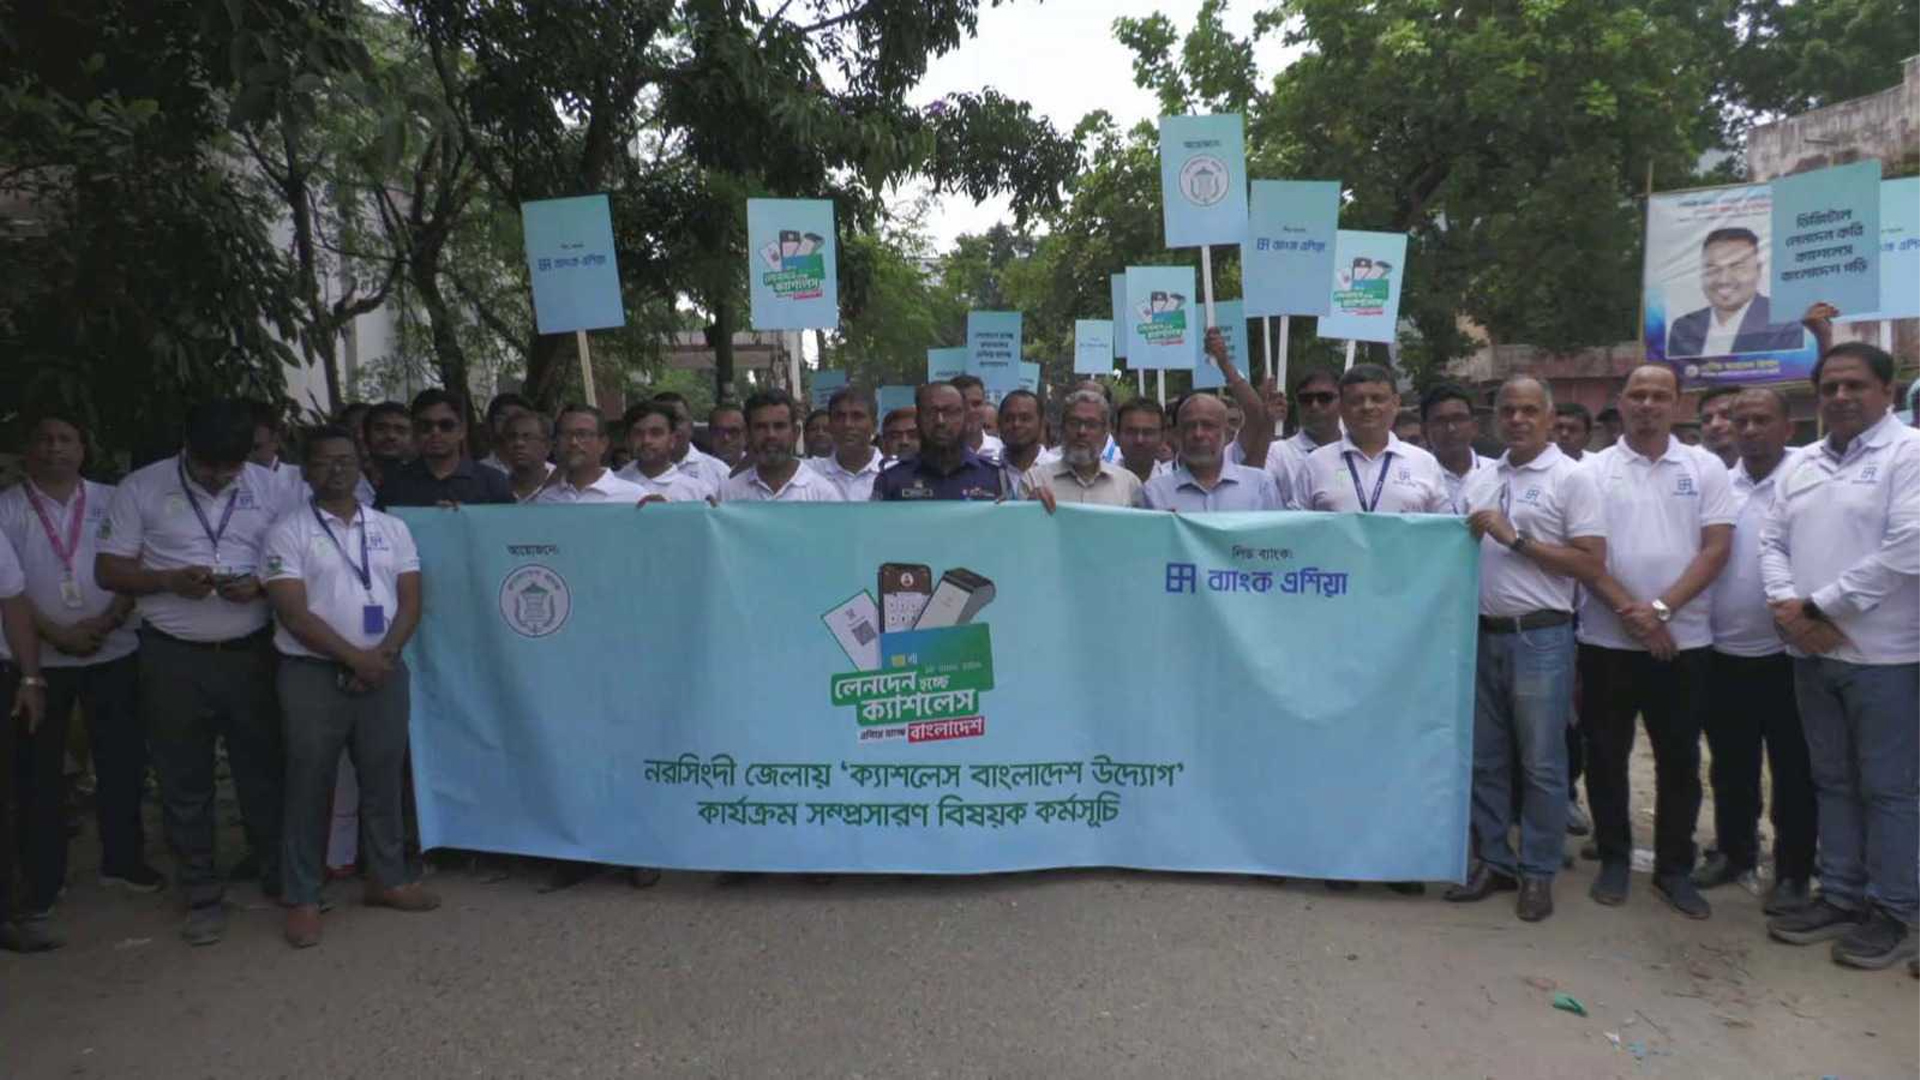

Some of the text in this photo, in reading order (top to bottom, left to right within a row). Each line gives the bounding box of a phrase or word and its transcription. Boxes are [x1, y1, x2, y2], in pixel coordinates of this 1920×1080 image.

[1208, 566, 1349, 598] ব্যাংক এশিয়া
[834, 671, 919, 699] লেনদেন
[861, 688, 977, 721] ক্যাশলেস
[908, 718, 983, 740] বাংলাদেশ
[643, 753, 738, 788] নরসিংদী
[744, 763, 832, 789] জেলায়
[969, 761, 1085, 790] বাংলাদেশ
[697, 791, 1122, 828] কার্যক্রম সম্প্রসারণ বিষয়ক কর্মসূচি
